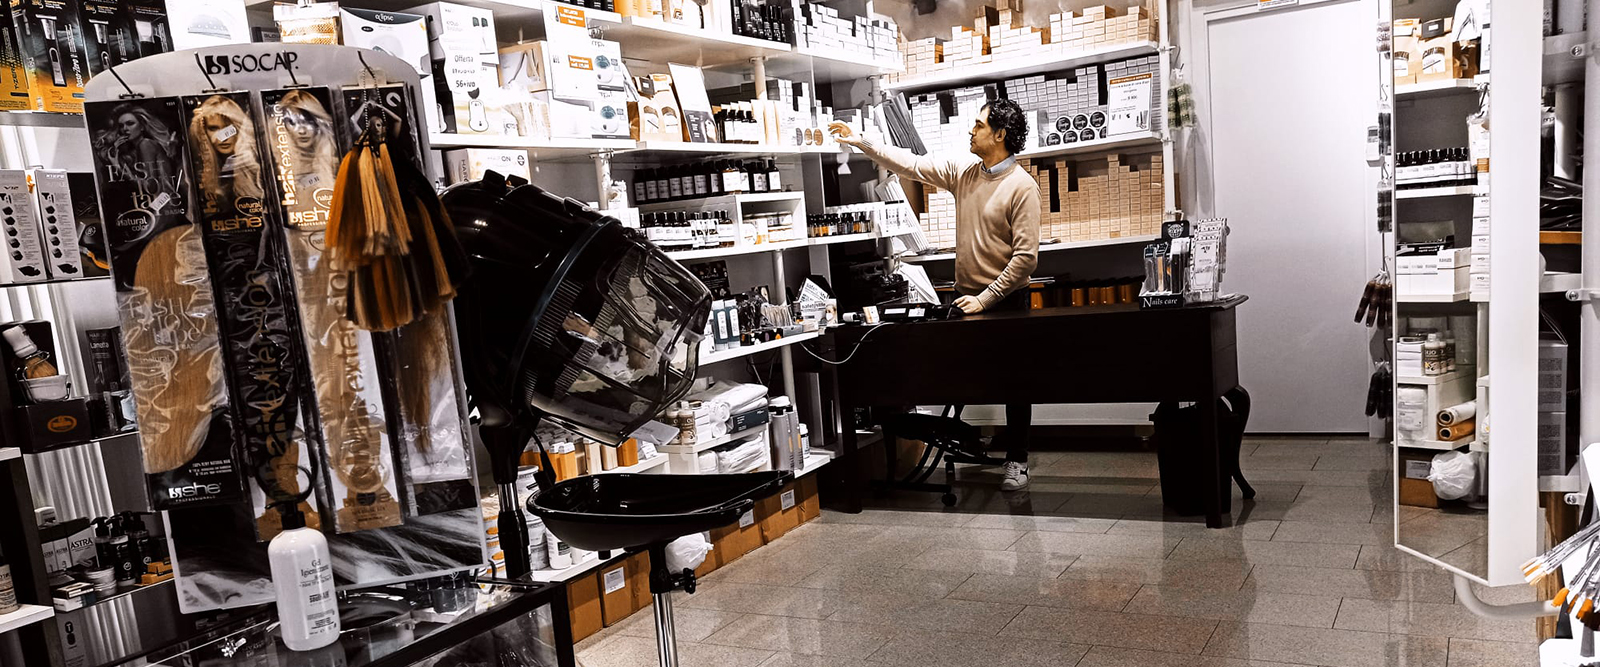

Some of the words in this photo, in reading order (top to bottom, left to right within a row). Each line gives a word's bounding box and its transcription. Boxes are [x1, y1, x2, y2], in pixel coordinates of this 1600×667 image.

[116, 215, 148, 227] natural
[302, 207, 331, 223] sh
[132, 223, 149, 232] color
[225, 215, 262, 231] she
[1142, 297, 1163, 308] Nails
[1164, 297, 1178, 305] care
[182, 481, 221, 497] she
[70, 537, 93, 549] ASTRA
